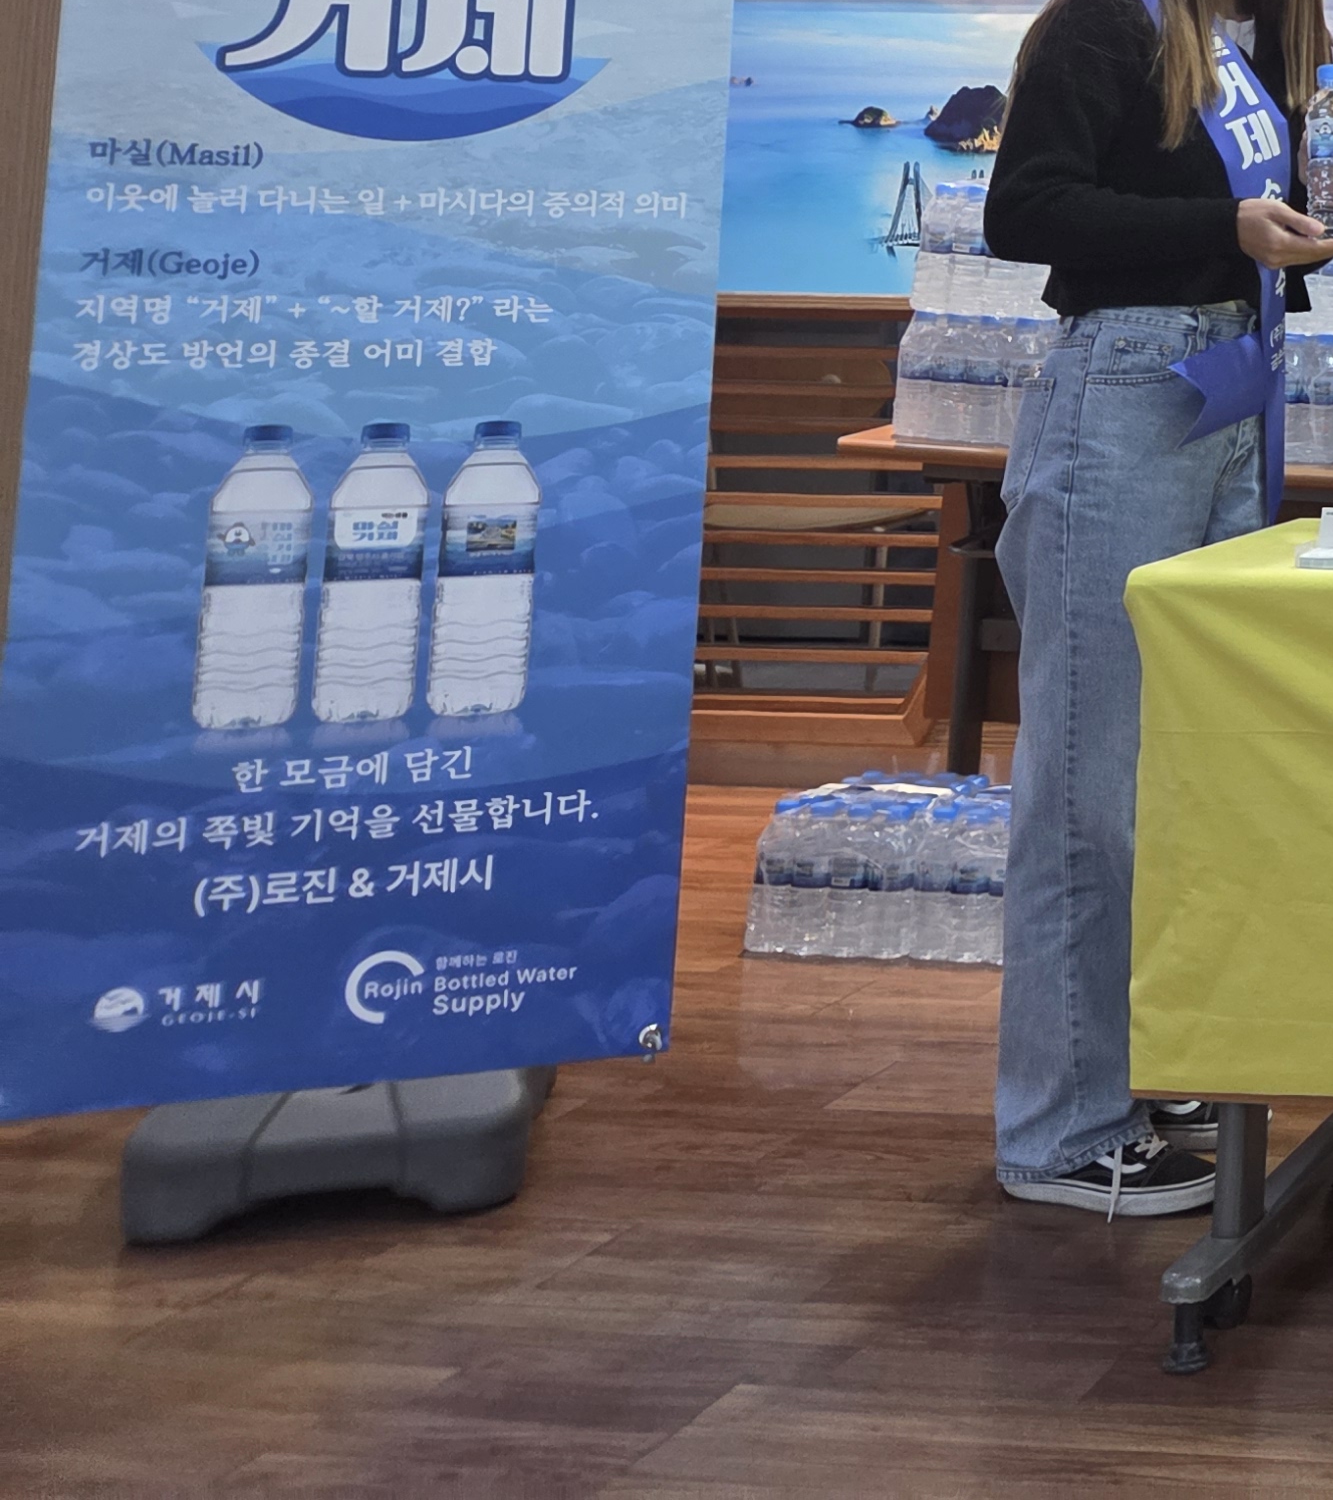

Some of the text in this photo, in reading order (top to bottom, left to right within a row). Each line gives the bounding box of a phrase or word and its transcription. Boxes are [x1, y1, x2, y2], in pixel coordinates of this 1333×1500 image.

[89, 137, 264, 169] 마실(Masil)
[86, 182, 179, 213] 이웃에
[187, 186, 248, 214] 놀러
[258, 186, 350, 215] 다니는
[358, 187, 386, 216] 일
[420, 188, 535, 217] 마시다의
[542, 190, 626, 219] 중의적
[633, 191, 688, 219] 의미
[79, 247, 260, 280] 거제(Geoje)
[75, 295, 172, 325] 지역명
[493, 296, 554, 324] 라는
[71, 337, 498, 372] 경상도 방언의 종결 어미 결합
[232, 746, 474, 794] 한 모금에 담긴
[75, 788, 599, 859] 거제의 쪽빛 기억을 선물합니다.
[194, 853, 495, 918] (주)로진 & 거제시
[364, 966, 578, 1000] Rojin Bottled Water
[432, 989, 526, 1017] Supply
